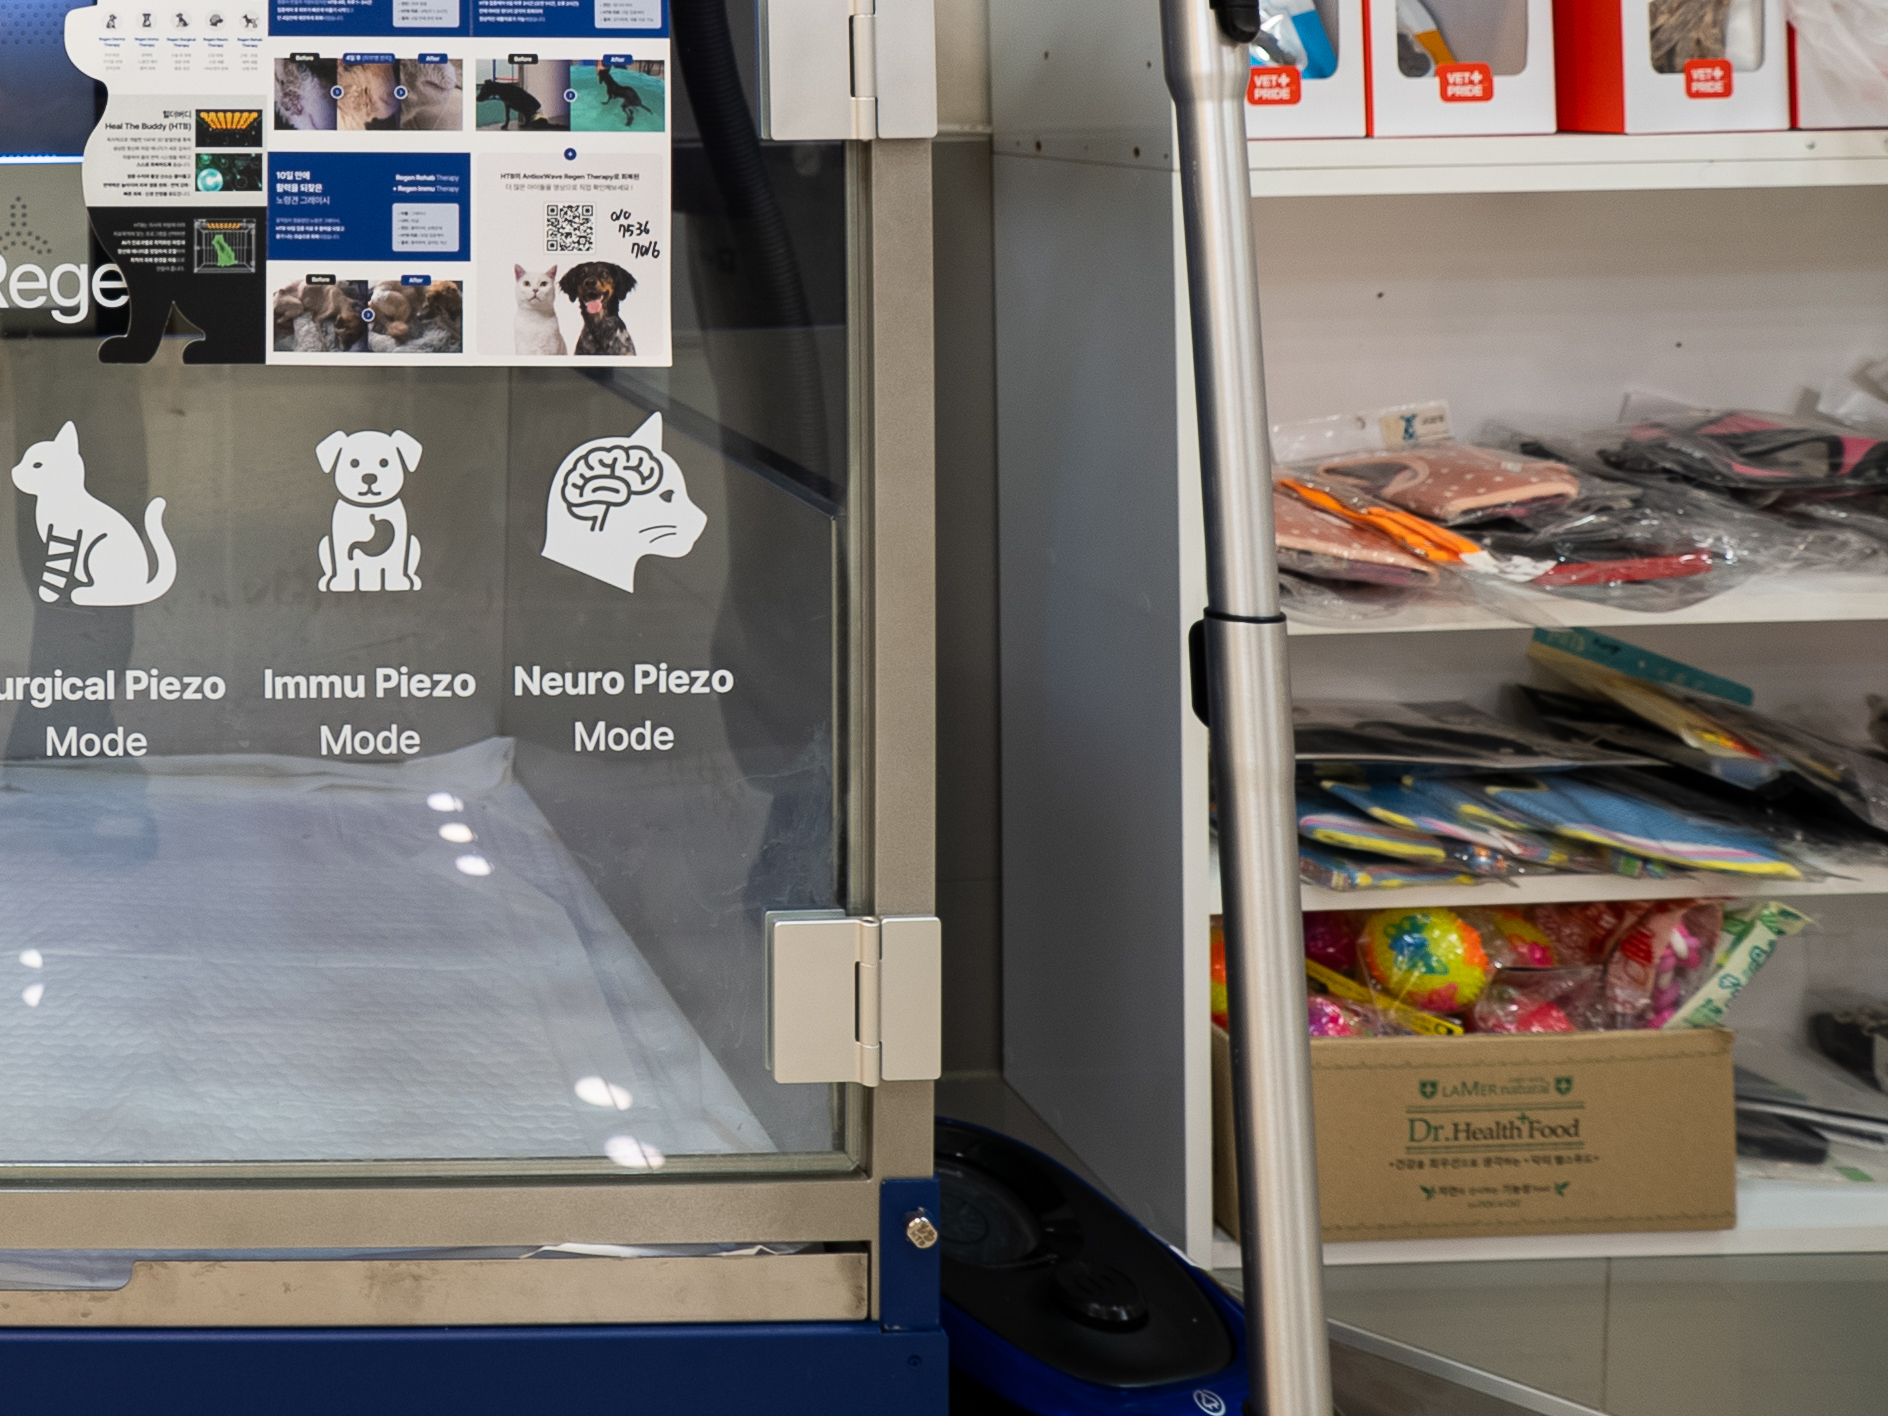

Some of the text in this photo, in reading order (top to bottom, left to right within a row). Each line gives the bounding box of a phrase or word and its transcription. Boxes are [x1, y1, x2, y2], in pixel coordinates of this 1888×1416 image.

[105, 122, 192, 132] Heal The Buddy (HTB)
[126, 669, 225, 700] Piezo
[264, 666, 476, 700] Immu Piezo
[514, 663, 734, 697] Neuro Piezo
[47, 727, 148, 757] Mode
[320, 724, 421, 755] Mode
[575, 720, 674, 752] Mode
[1529, 1118, 1580, 1139] Food
